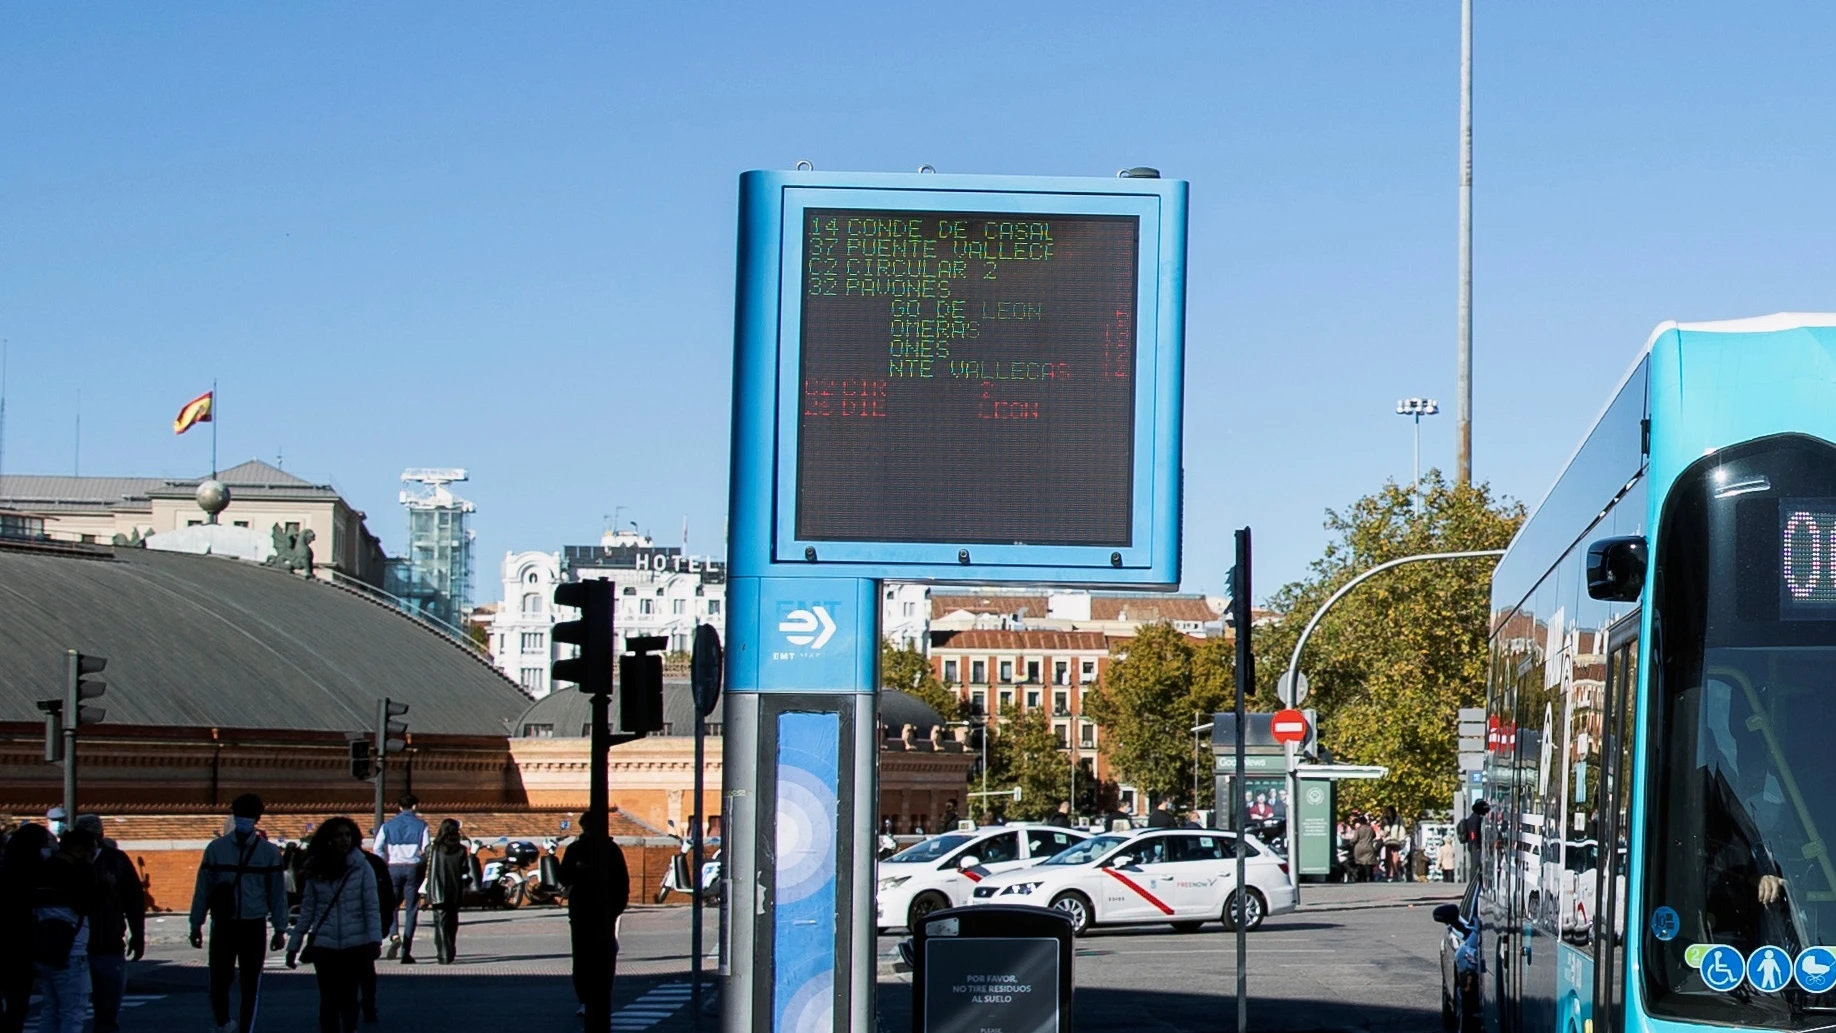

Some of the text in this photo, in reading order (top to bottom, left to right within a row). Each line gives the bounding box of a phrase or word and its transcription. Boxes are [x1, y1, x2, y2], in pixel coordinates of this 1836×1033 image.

[813, 218, 1053, 241] 14 CONDE DE CASAL
[810, 238, 838, 256] 37
[847, 238, 936, 258] PUENTE
[809, 258, 997, 279] C2 CIRCULAR 2
[808, 277, 951, 298] 32 PAVONES
[936, 299, 966, 318] DE
[982, 301, 1042, 321] LEON
[889, 359, 934, 378] NTE
[635, 553, 719, 573] HOTEL
[773, 652, 795, 660] EMT
[953, 984, 1033, 993] NO TIRE RESIDUOS
[966, 975, 1018, 983] POR FAVOR,
[971, 995, 1013, 1003] AL SUELO
